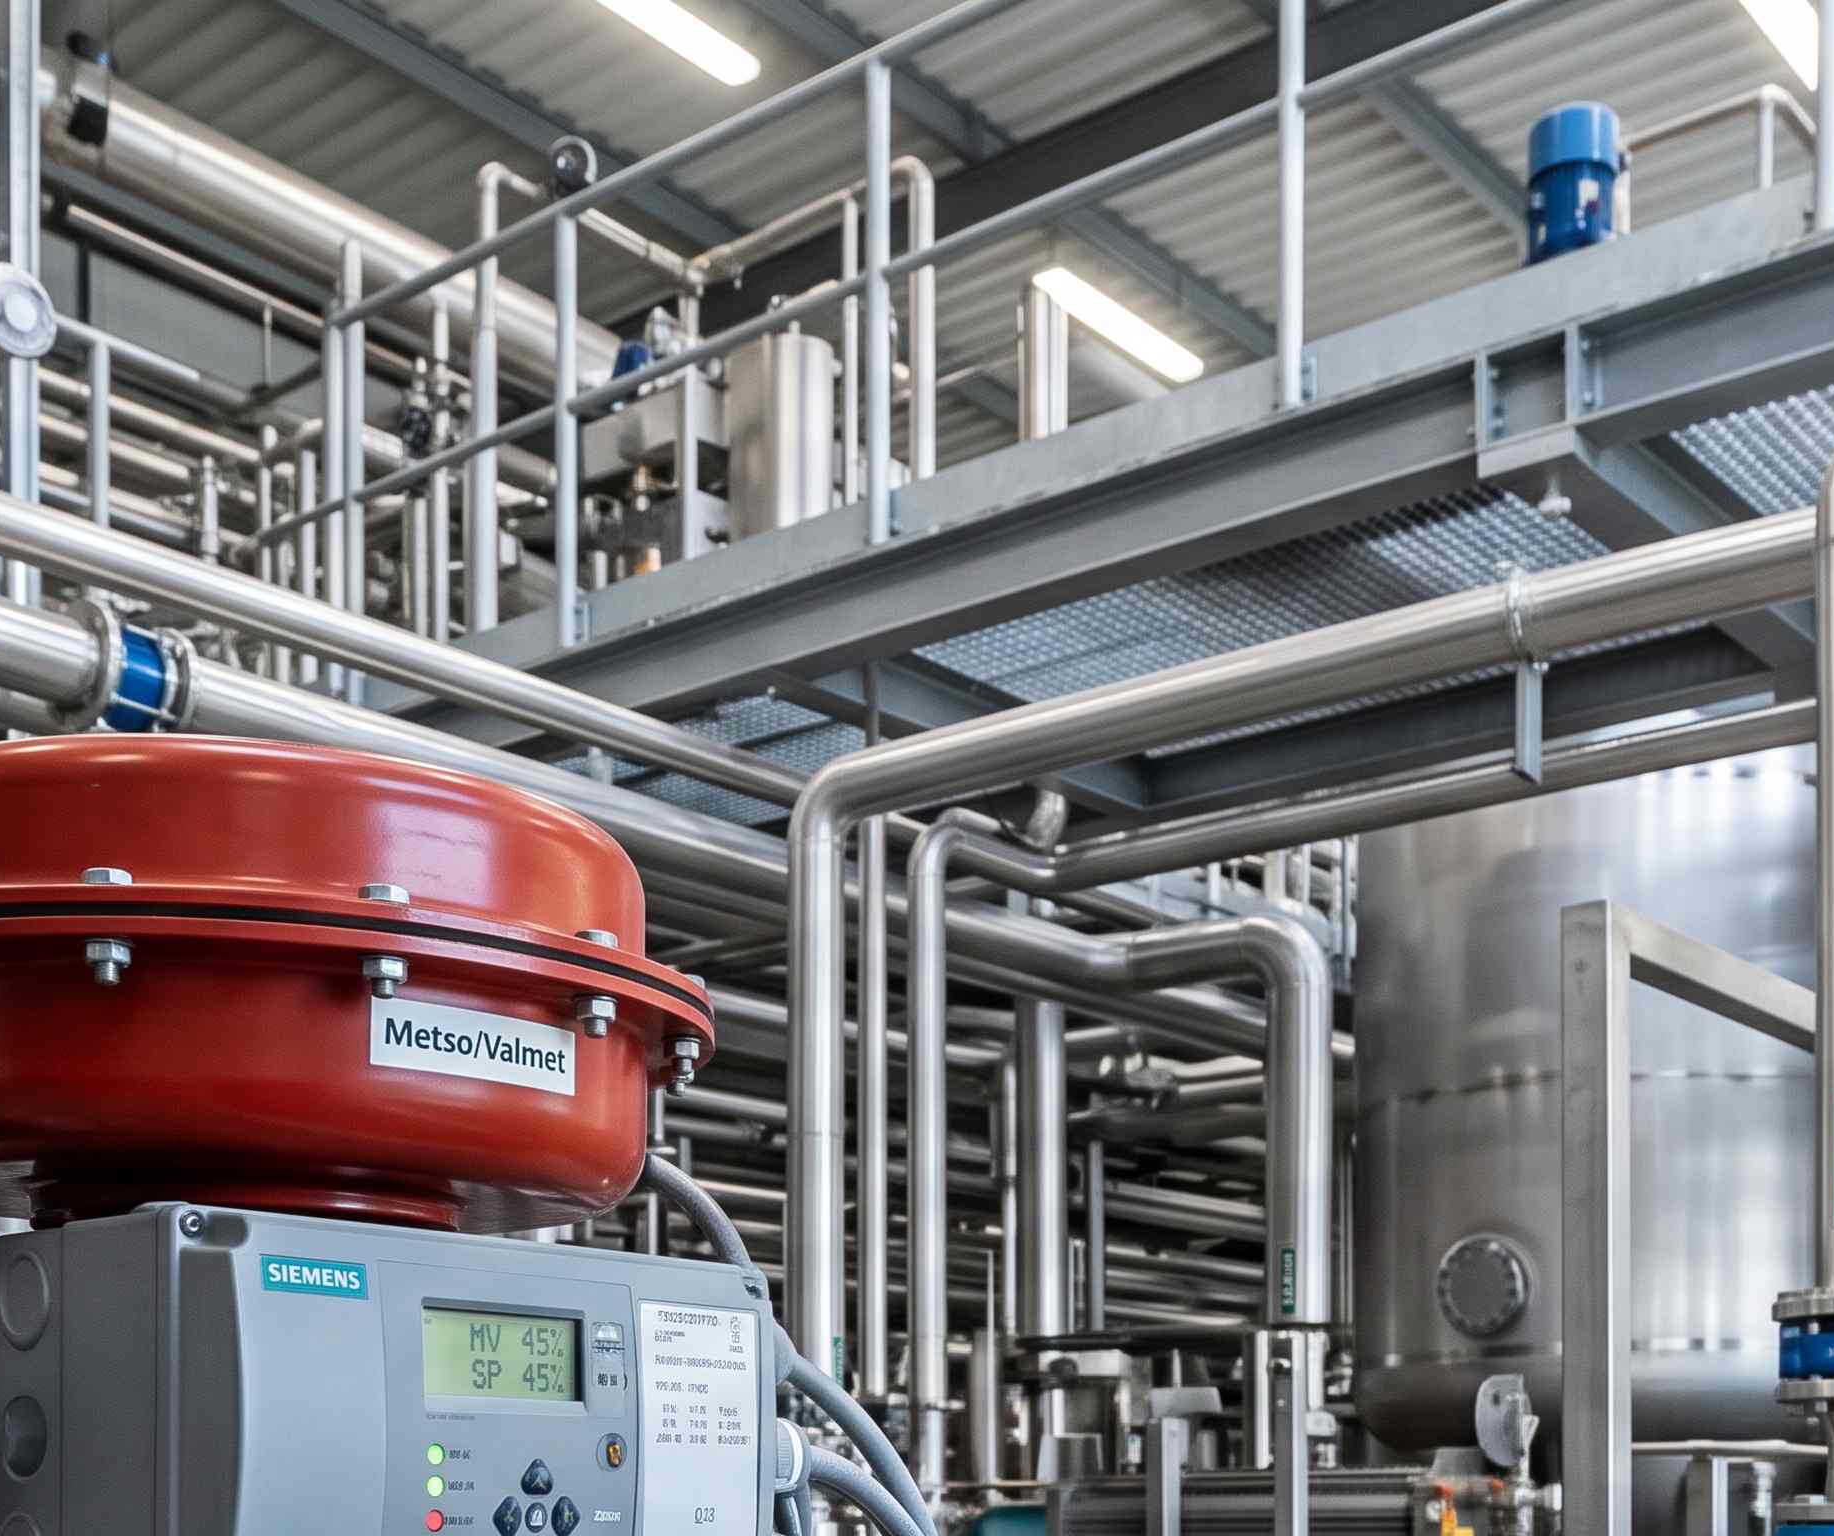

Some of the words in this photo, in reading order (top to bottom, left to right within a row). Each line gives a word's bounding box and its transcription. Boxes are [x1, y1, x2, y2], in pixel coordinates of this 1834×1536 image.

[384, 1017, 566, 1074] Metso/Valmet
[267, 1262, 361, 1290] SIEMENS
[469, 1322, 502, 1353] MV
[521, 1326, 566, 1358] 45%
[471, 1359, 503, 1390] SP
[521, 1363, 566, 1393] 45%
